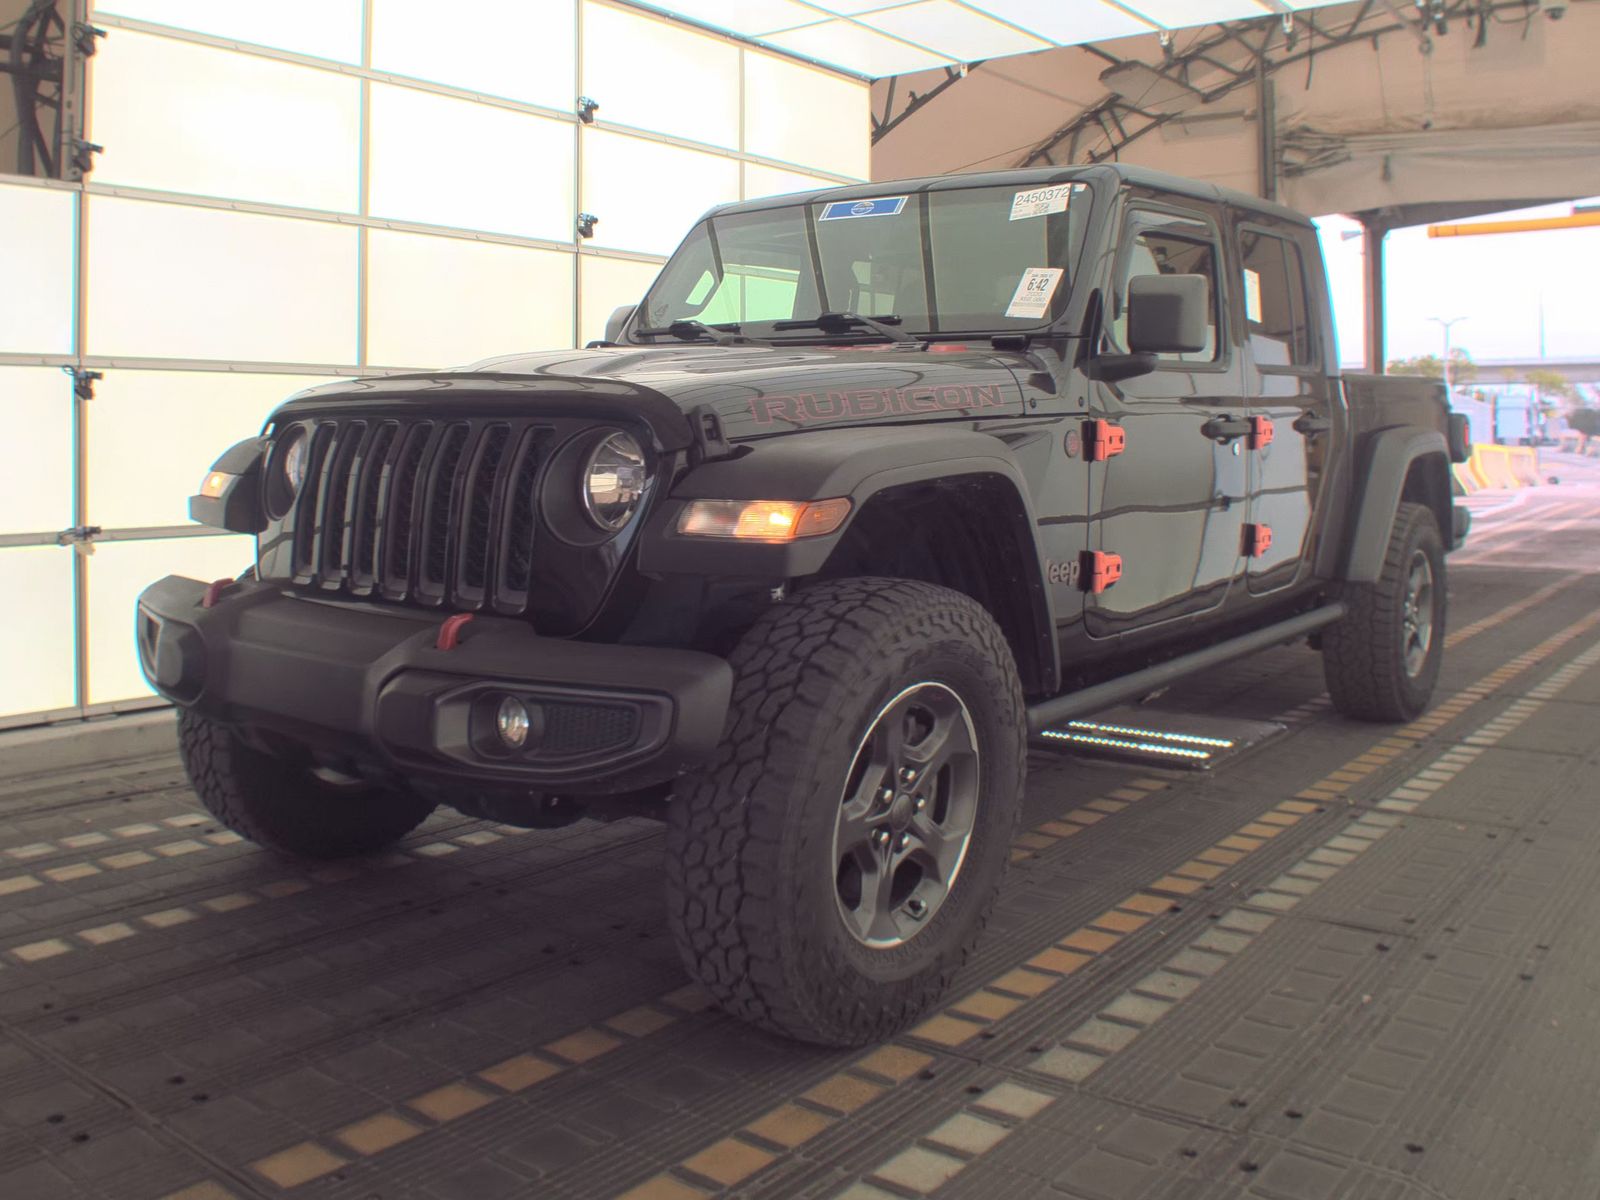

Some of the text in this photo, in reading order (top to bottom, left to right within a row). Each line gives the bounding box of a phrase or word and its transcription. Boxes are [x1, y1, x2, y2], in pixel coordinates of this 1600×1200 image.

[1015, 186, 1069, 206] 2450372
[1027, 278, 1049, 291] 6:42
[750, 384, 1003, 423] RUBICON
